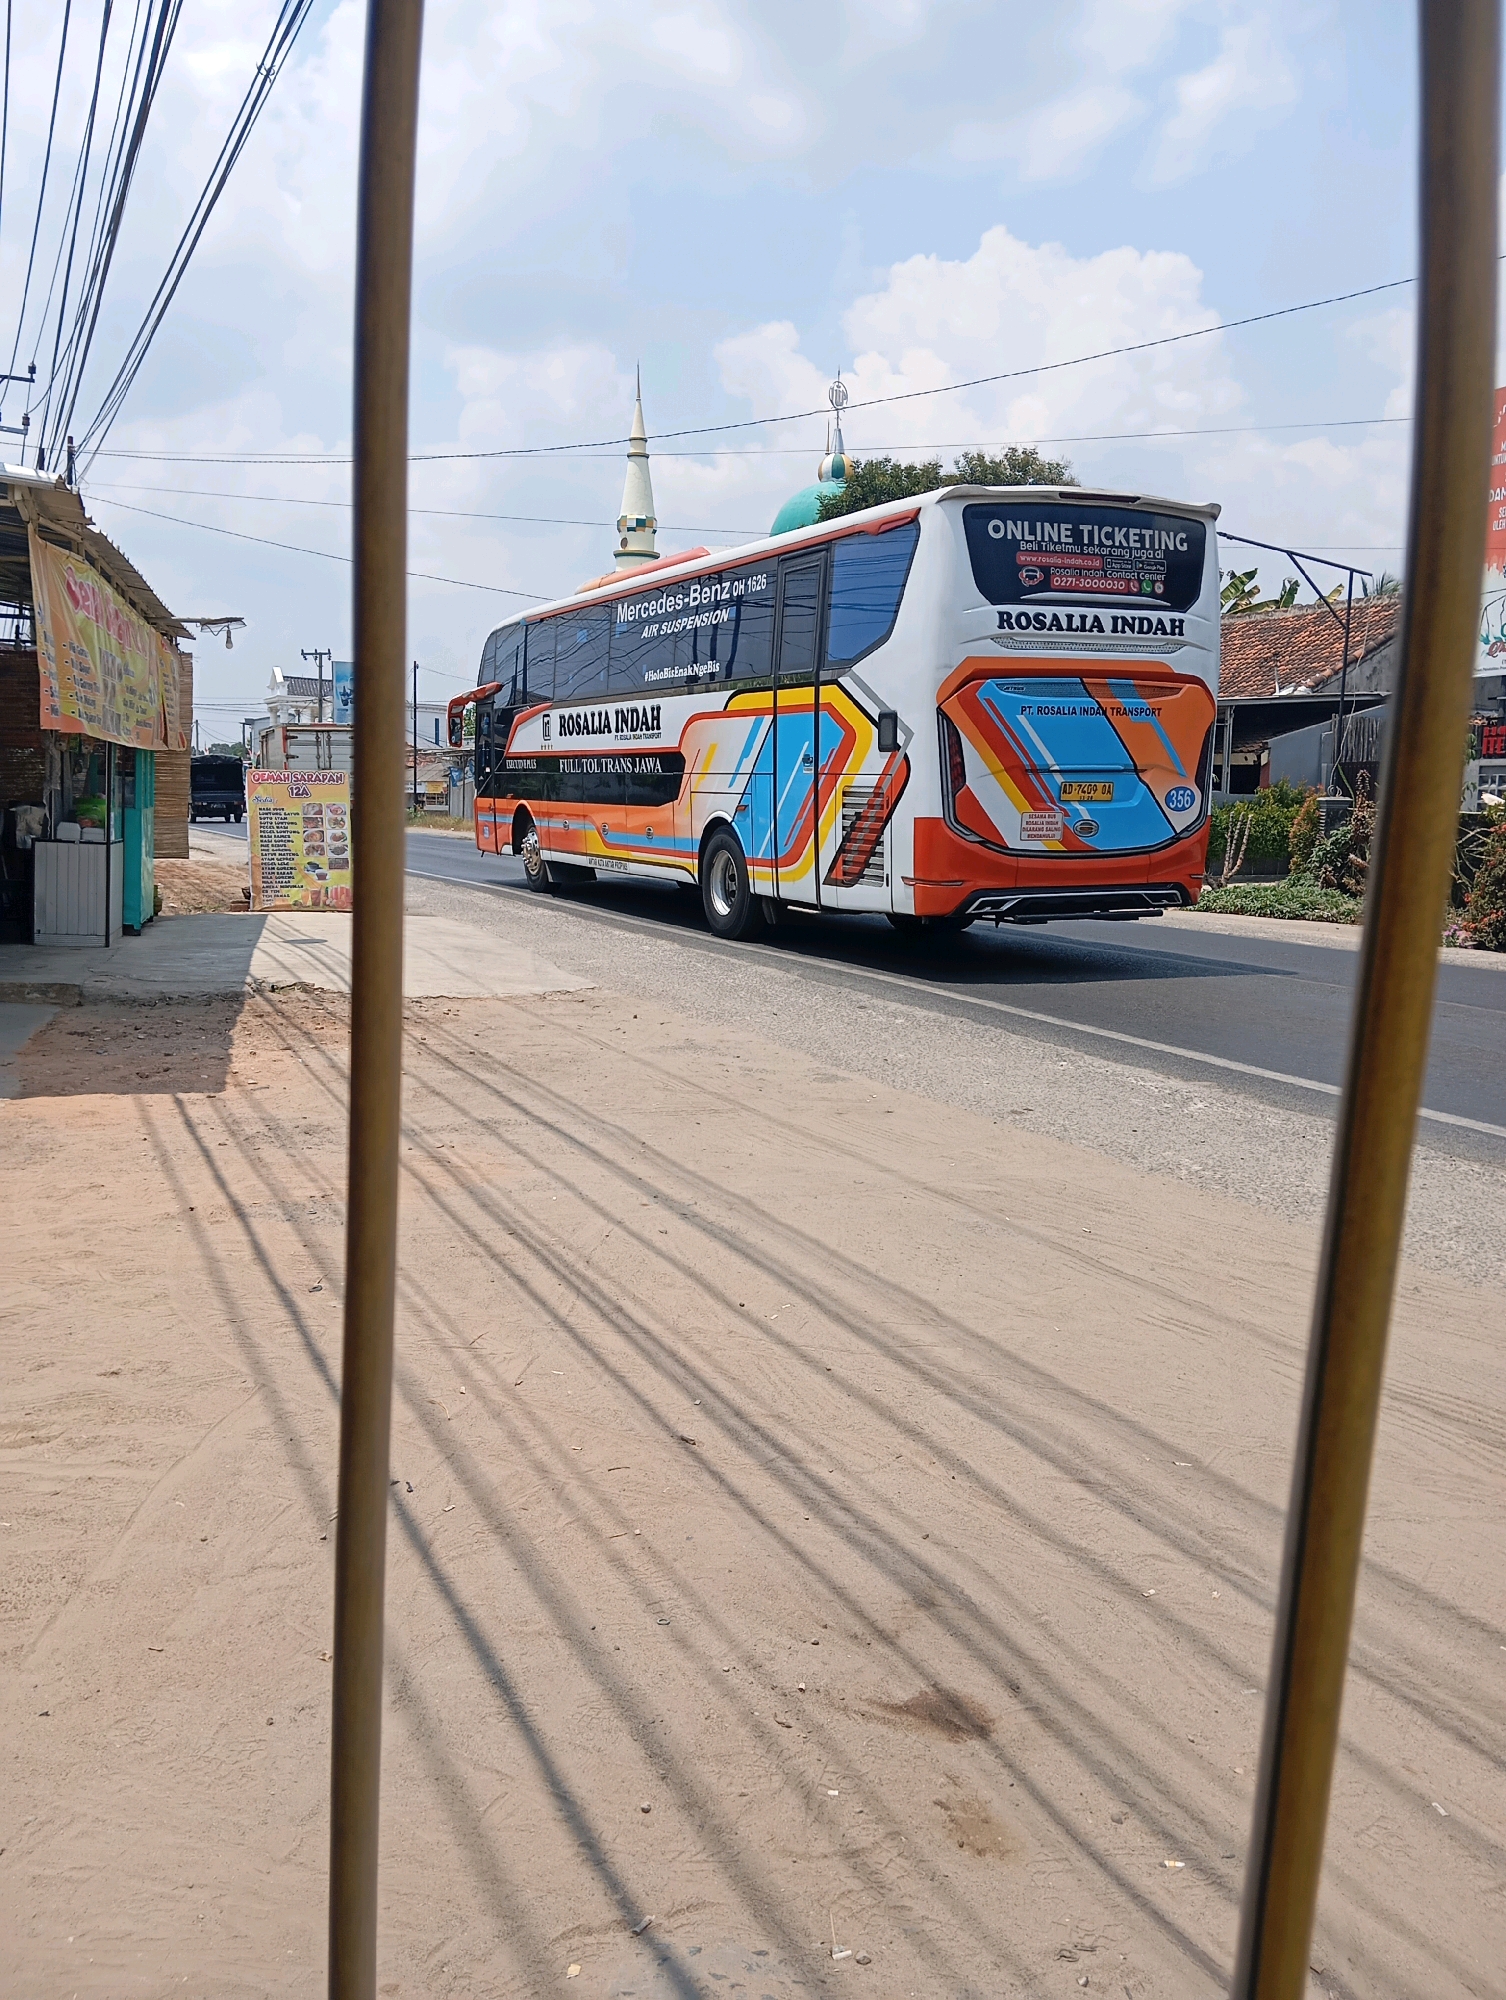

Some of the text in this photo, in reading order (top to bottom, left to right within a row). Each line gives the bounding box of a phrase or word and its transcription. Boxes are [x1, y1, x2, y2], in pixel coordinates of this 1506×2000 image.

[988, 519, 1188, 551] ONLINE TICKETING
[1020, 541, 1164, 560] Beli Tiketmu sekarang juga di
[1020, 555, 1100, 566] www.rosalia-indah.co.id
[1050, 567, 1166, 580] Rosalia Indah Contact Center
[1053, 577, 1125, 590] 0271-3000030
[617, 574, 767, 623] Mercedes-Benz OH 1626
[641, 608, 731, 639] AIR SUSPENSION
[996, 611, 1185, 636] ROSALIA INDAH
[644, 660, 720, 682] #HoloBisEnakNgeBis
[1020, 705, 1162, 717] PT. ROSALIA INDAH TRANSPORT
[559, 704, 661, 737] ROSALIA INDAH
[559, 757, 663, 773] FULL TOL TRANS JAWA
[292, 771, 344, 784] SARAPAN
[288, 785, 311, 798] 12A
[1062, 783, 1073, 795] AD
[1169, 789, 1191, 808] 356
